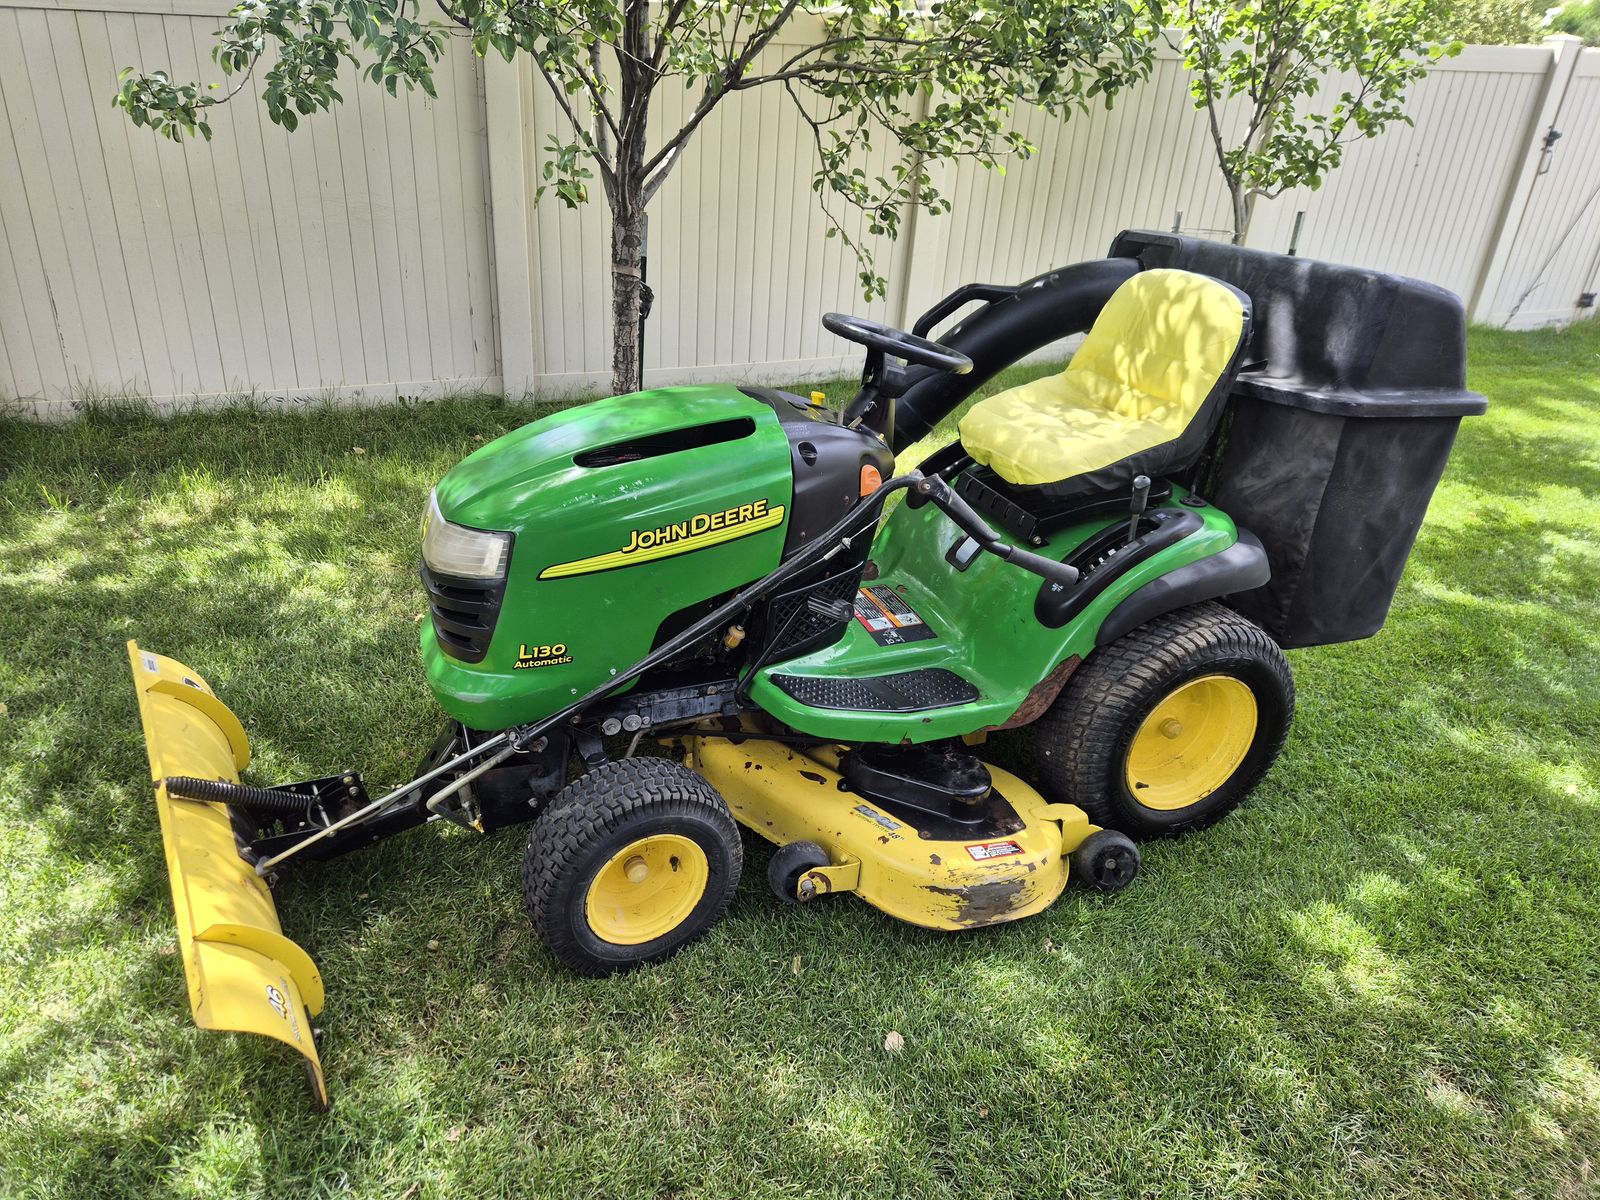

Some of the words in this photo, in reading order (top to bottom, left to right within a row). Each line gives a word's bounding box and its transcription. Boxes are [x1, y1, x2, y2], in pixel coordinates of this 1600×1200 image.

[621, 520, 687, 553] JOHN
[690, 498, 769, 537] DEERE
[513, 655, 573, 669] Automatic
[519, 643, 567, 660] L130
[265, 984, 288, 1020] 46
